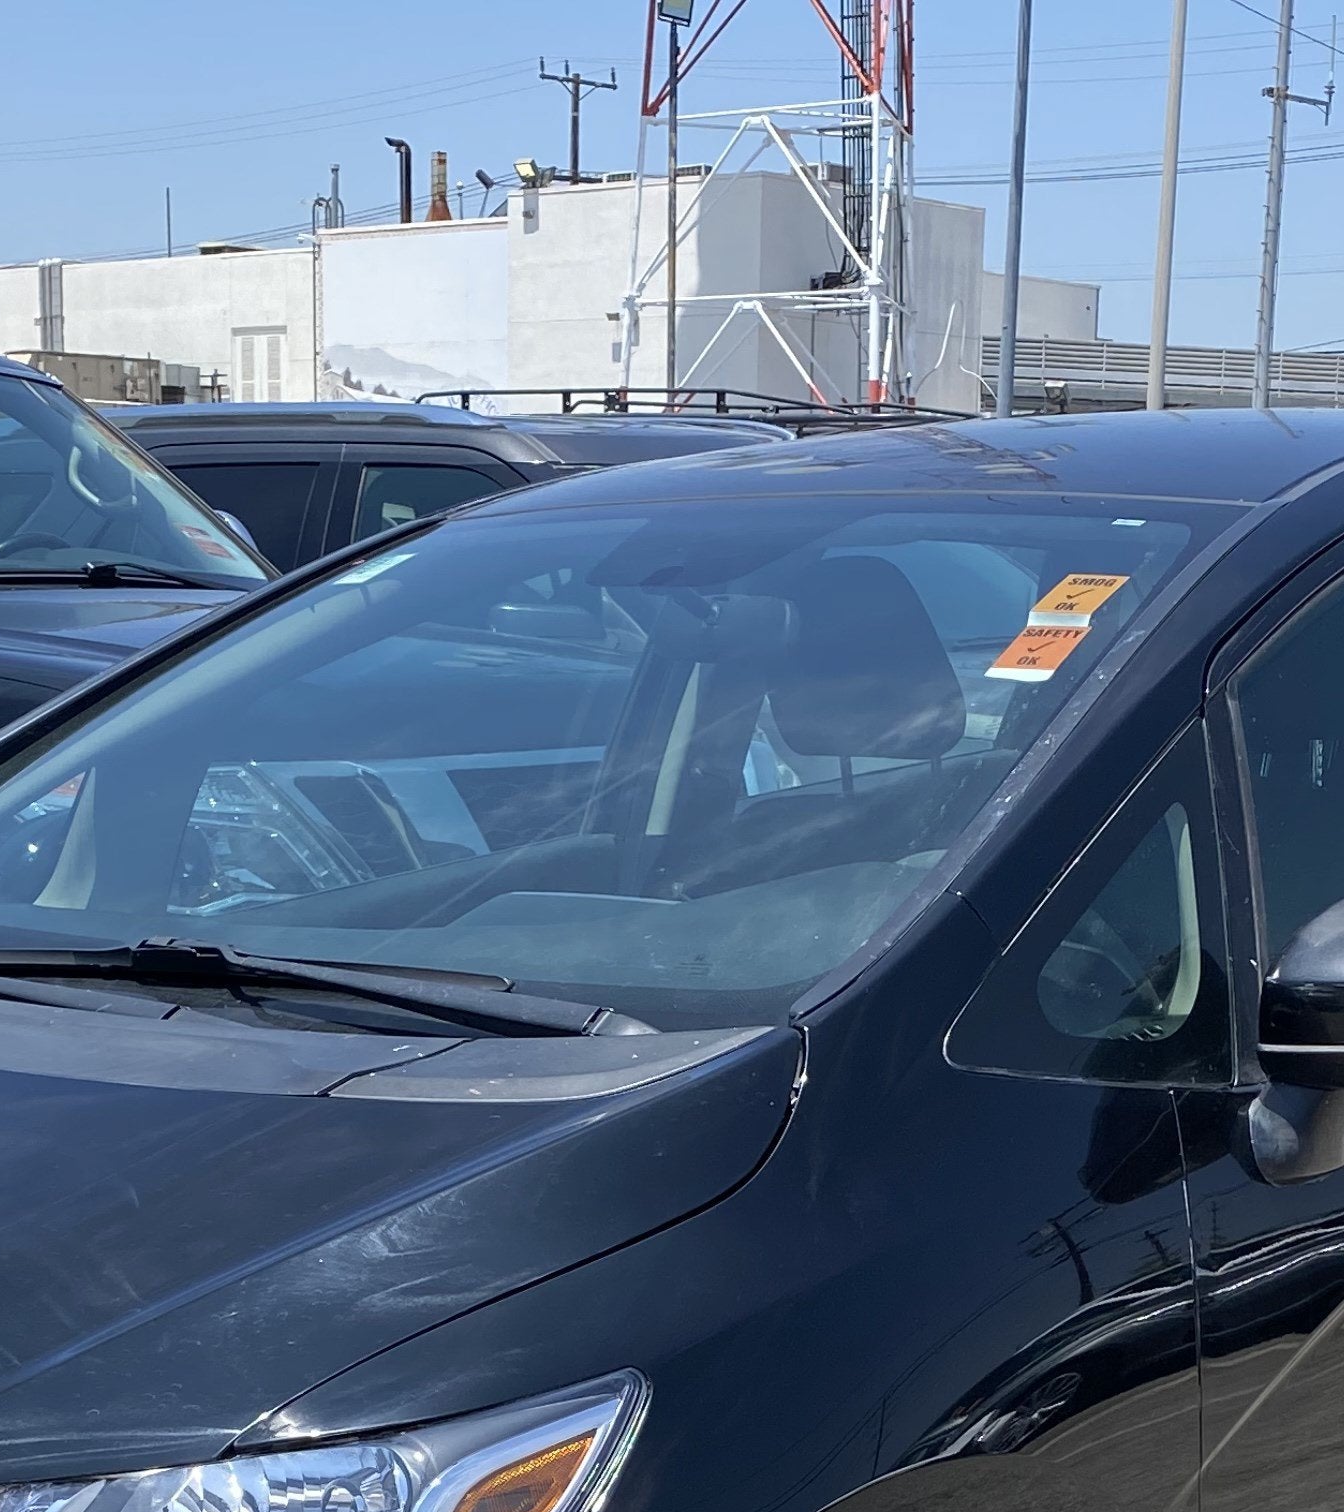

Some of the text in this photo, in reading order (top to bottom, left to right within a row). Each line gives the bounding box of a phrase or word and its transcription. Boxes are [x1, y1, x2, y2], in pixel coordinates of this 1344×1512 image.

[1068, 578, 1117, 587] SMOG
[1055, 602, 1079, 611] OK
[1023, 629, 1085, 638] SAFETY
[1017, 657, 1040, 665] OK
